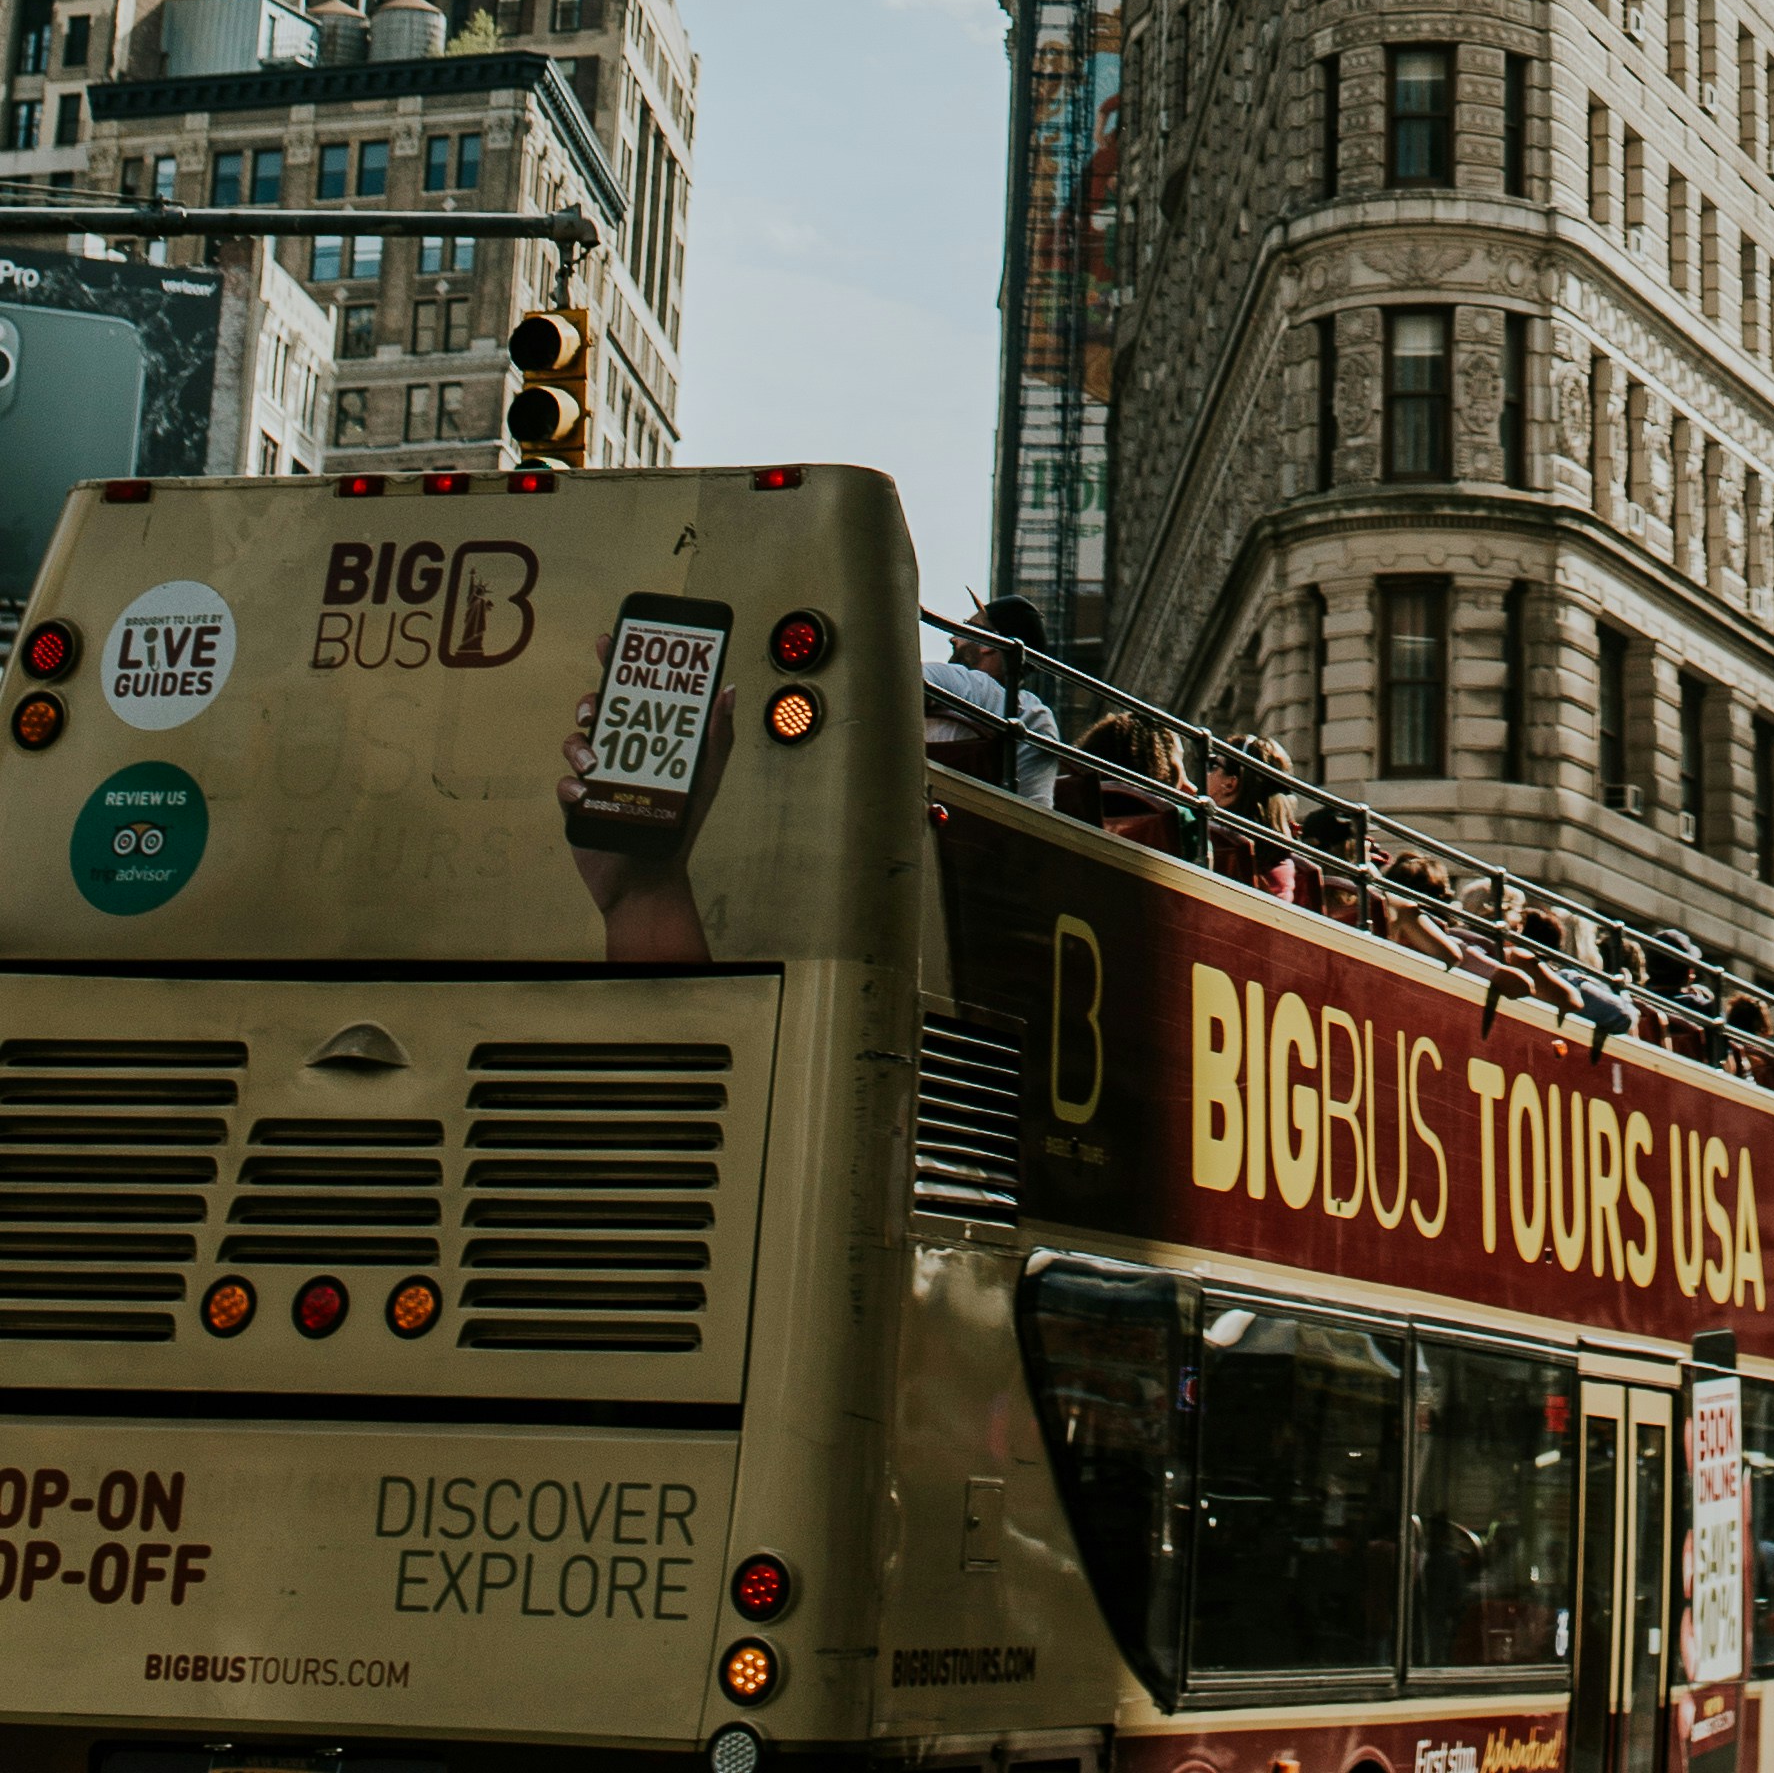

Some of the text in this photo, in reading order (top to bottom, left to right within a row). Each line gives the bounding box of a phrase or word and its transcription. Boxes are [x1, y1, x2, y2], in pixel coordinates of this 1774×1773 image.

[0, 259, 40, 288] Pro
[322, 540, 446, 606] BIG
[125, 613, 224, 627] BROUGHT TO LIFE BY
[312, 610, 434, 670] BUS
[620, 632, 713, 674] BOOK
[114, 670, 214, 698] GUIDES
[615, 664, 708, 696] ONLINE
[604, 696, 700, 738] SAVE
[599, 730, 688, 780] 10%
[105, 791, 188, 807] REVIEW US
[1467, 1057, 1657, 1288] TOURS
[1670, 1123, 1766, 1312] USA
[1698, 1407, 1736, 1461] BOOK
[375, 1475, 697, 1546] DISCOVER
[395, 1549, 694, 1621] EXPLORE
[144, 1653, 411, 1689] BIGBUSTOURS.COM
